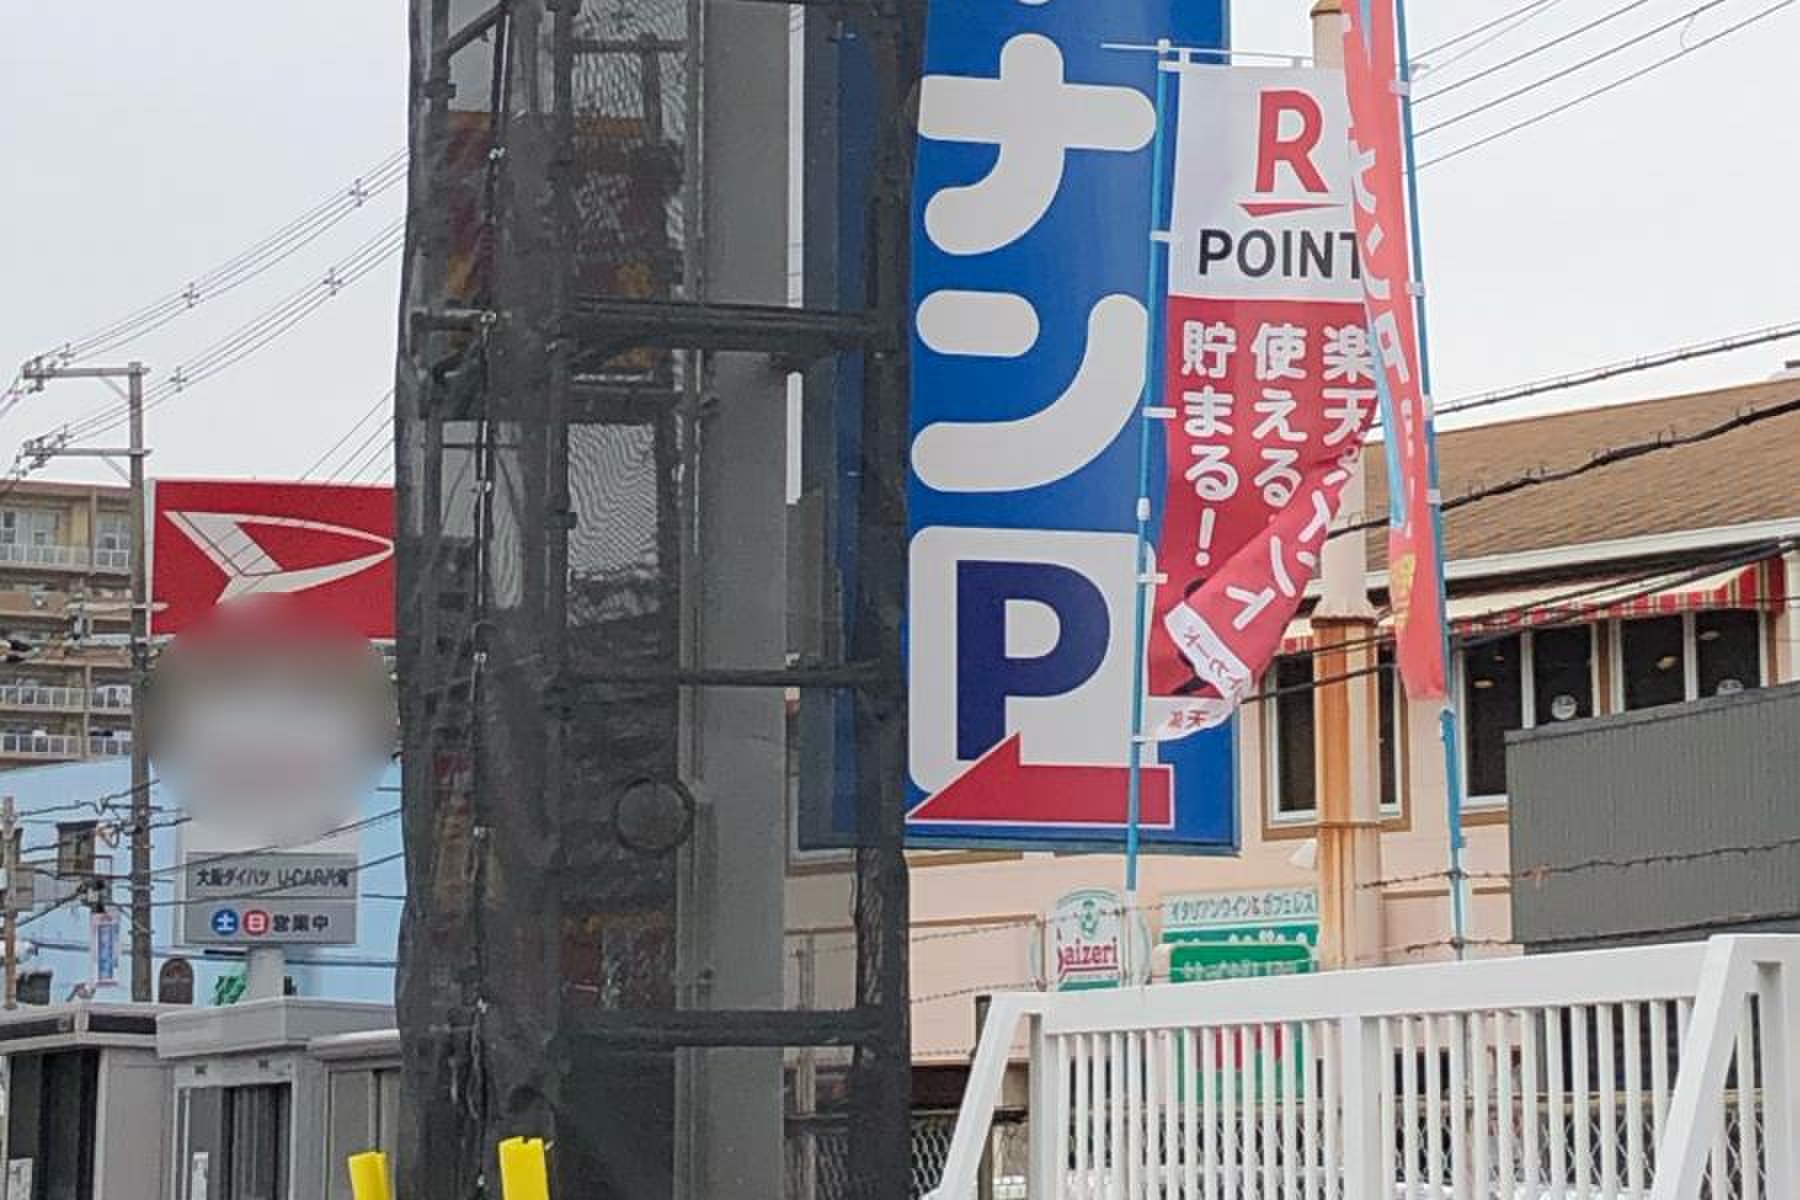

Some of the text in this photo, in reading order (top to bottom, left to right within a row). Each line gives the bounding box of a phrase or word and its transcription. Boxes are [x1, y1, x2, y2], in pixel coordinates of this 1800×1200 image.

[1255, 89, 1329, 195] R
[1198, 229, 1362, 280] POINT
[1251, 322, 1308, 508] 使える
[956, 559, 1111, 761] P
